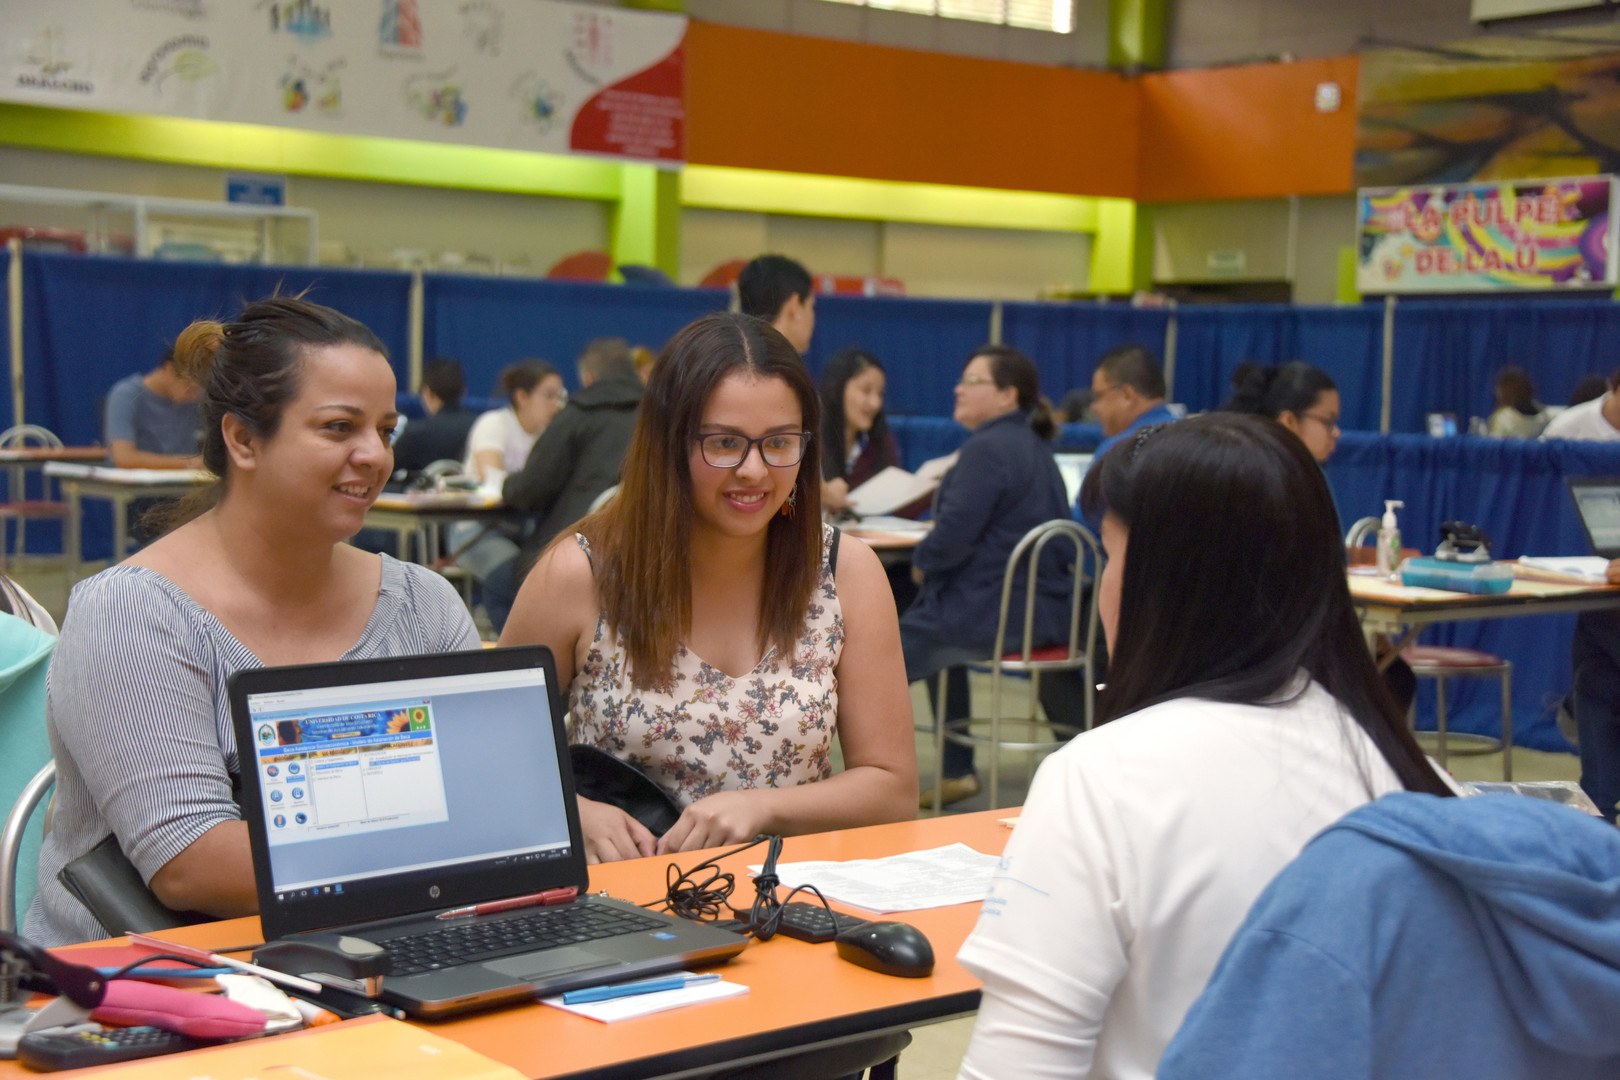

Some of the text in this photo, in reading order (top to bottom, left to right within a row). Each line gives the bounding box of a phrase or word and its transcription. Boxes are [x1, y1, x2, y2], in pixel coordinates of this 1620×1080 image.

[1404, 197, 1558, 228] LA PULPE
[1415, 250, 1453, 274] DE
[1466, 249, 1501, 273] LA
